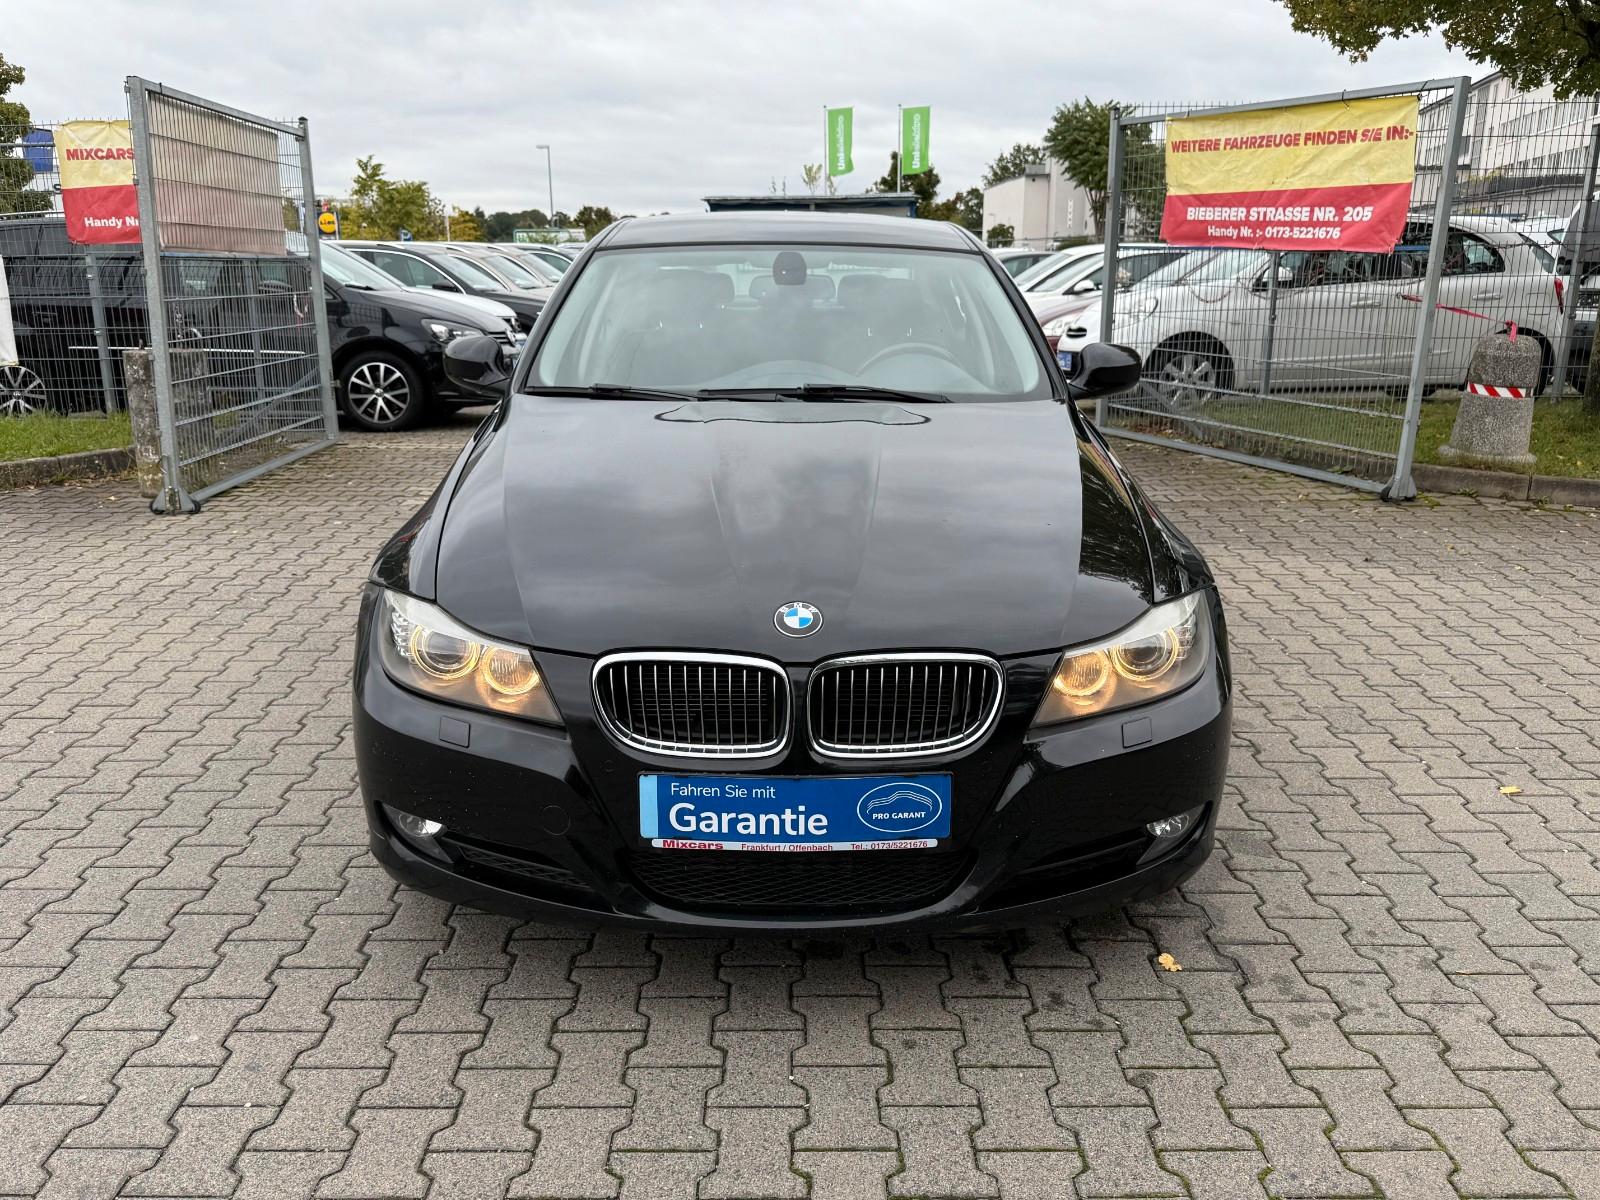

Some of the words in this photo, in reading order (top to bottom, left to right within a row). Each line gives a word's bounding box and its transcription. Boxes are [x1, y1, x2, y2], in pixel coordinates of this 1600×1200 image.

[1171, 138, 1221, 153] WEITERE
[1223, 132, 1300, 150] FAHRZEUGE
[1303, 129, 1357, 146] FINDEN
[66, 147, 135, 161] MIXCARS
[1186, 206, 1247, 222] BIEBERER
[1249, 207, 1310, 222] STRASSE
[1313, 208, 1339, 222] NR.
[1343, 206, 1374, 222] 205
[84, 216, 122, 229] Handy
[1207, 225, 1238, 239] Handy
[1240, 226, 1254, 238] Nr.
[1265, 227, 1341, 239] 0173-5221676
[671, 782, 721, 797] Fahren
[725, 784, 747, 798] Sie
[752, 786, 776, 799] mit
[669, 802, 829, 836] Garantie
[891, 811, 927, 819] GARANT
[662, 839, 724, 850] Mixcars
[741, 843, 781, 852] Frankfurt
[788, 844, 833, 852] Offenbach
[870, 841, 928, 849] 0173/5221676
